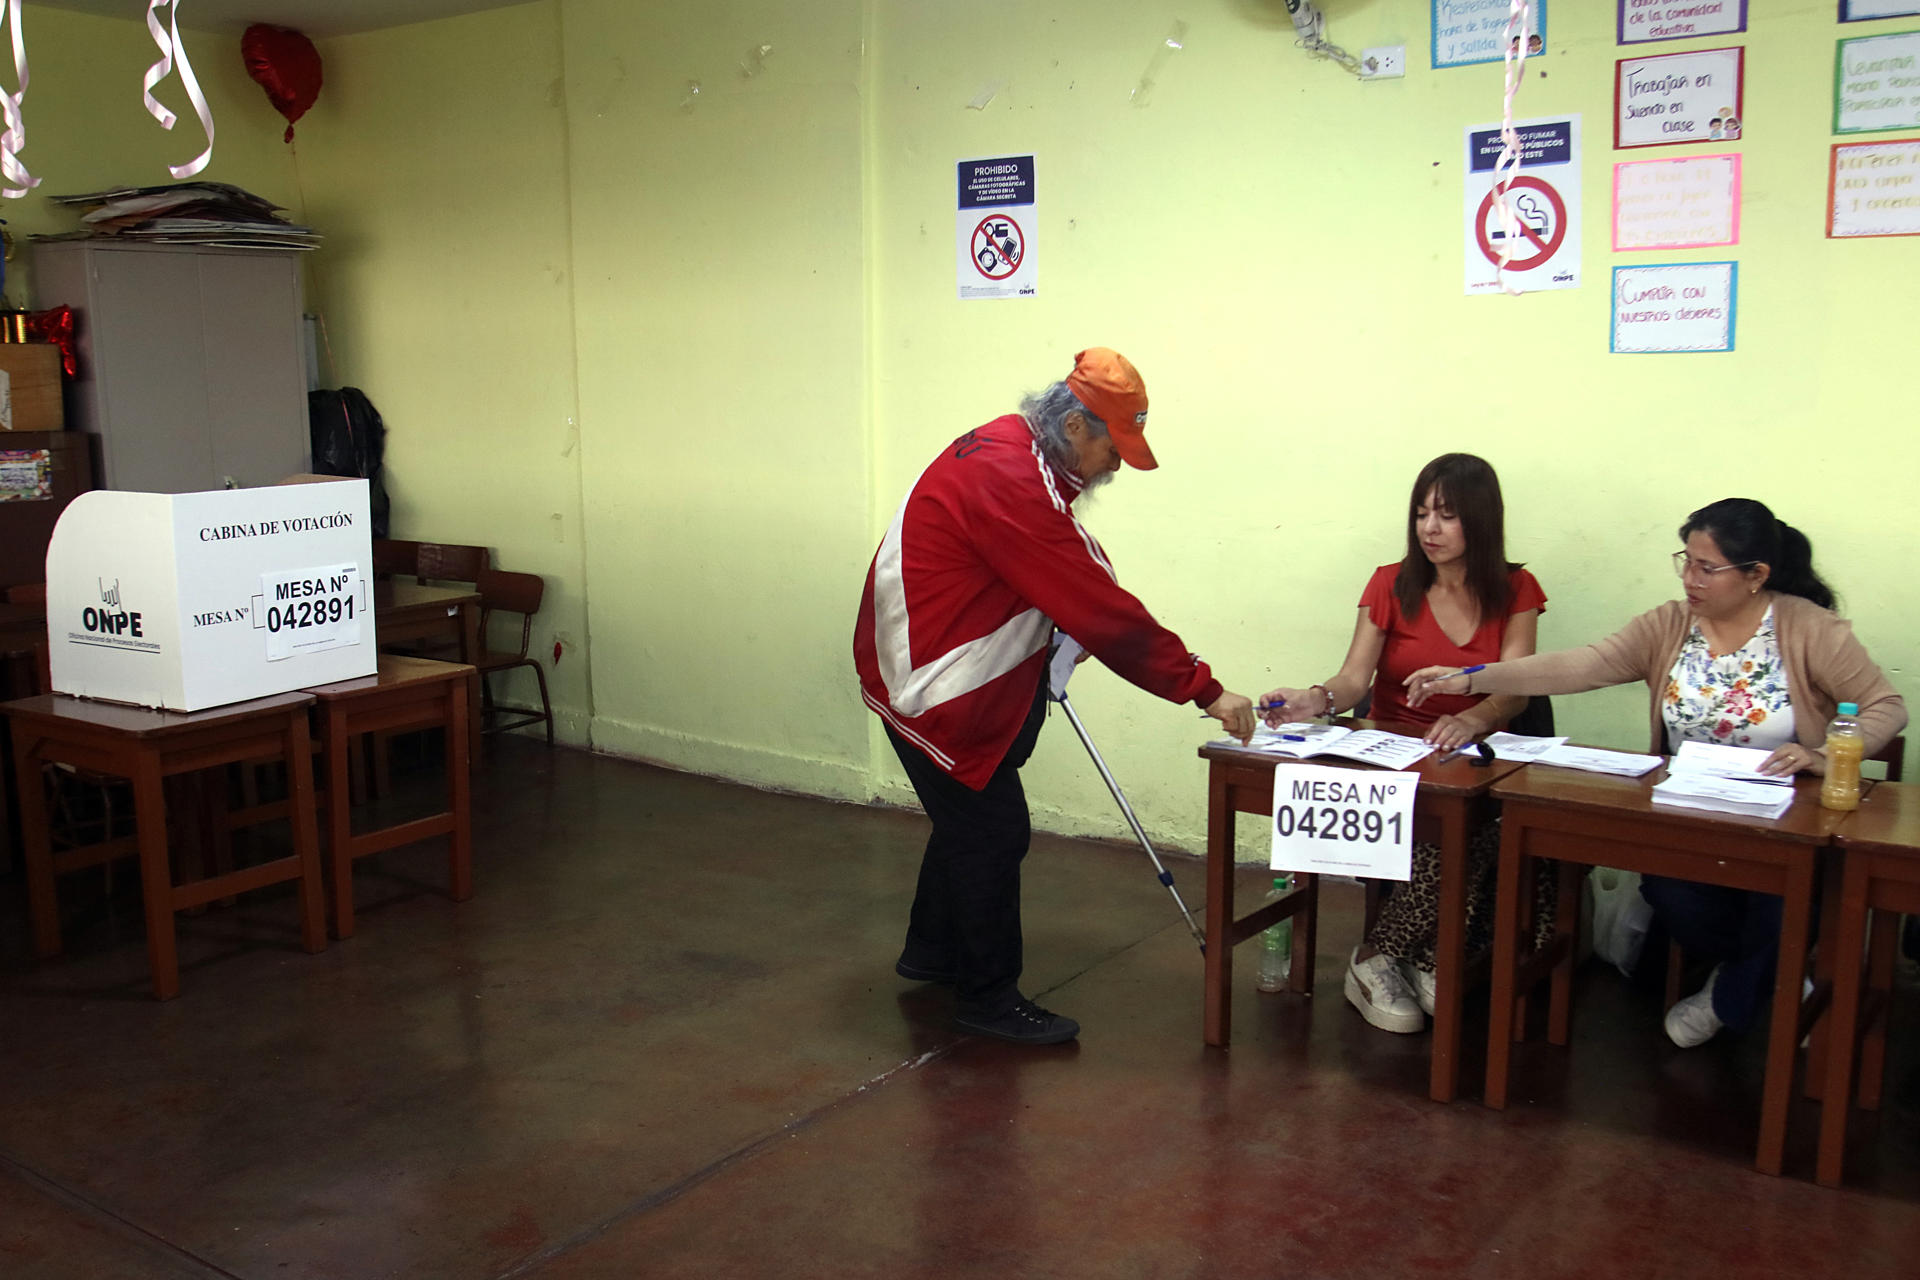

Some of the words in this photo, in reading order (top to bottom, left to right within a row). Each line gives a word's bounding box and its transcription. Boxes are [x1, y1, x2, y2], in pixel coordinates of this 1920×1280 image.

[1695, 74, 1712, 88] en
[1669, 102, 1684, 114] en
[1529, 130, 1557, 139] FUMAR
[1480, 146, 1490, 154] EN
[1525, 139, 1564, 149] PÚBLICOS
[1525, 150, 1544, 158] ESTE
[974, 164, 1018, 176] PROHIBIDO
[1552, 274, 1575, 282] ONPE
[199, 523, 257, 542] CABINA
[260, 520, 280, 536] DE
[282, 511, 353, 533] VOTACIÓN
[275, 578, 327, 601] MESA
[193, 610, 233, 627] MESA
[267, 594, 354, 633] 042891
[83, 606, 143, 638] ONPE
[1292, 779, 1362, 804] MESA
[1277, 805, 1402, 845] 042891
